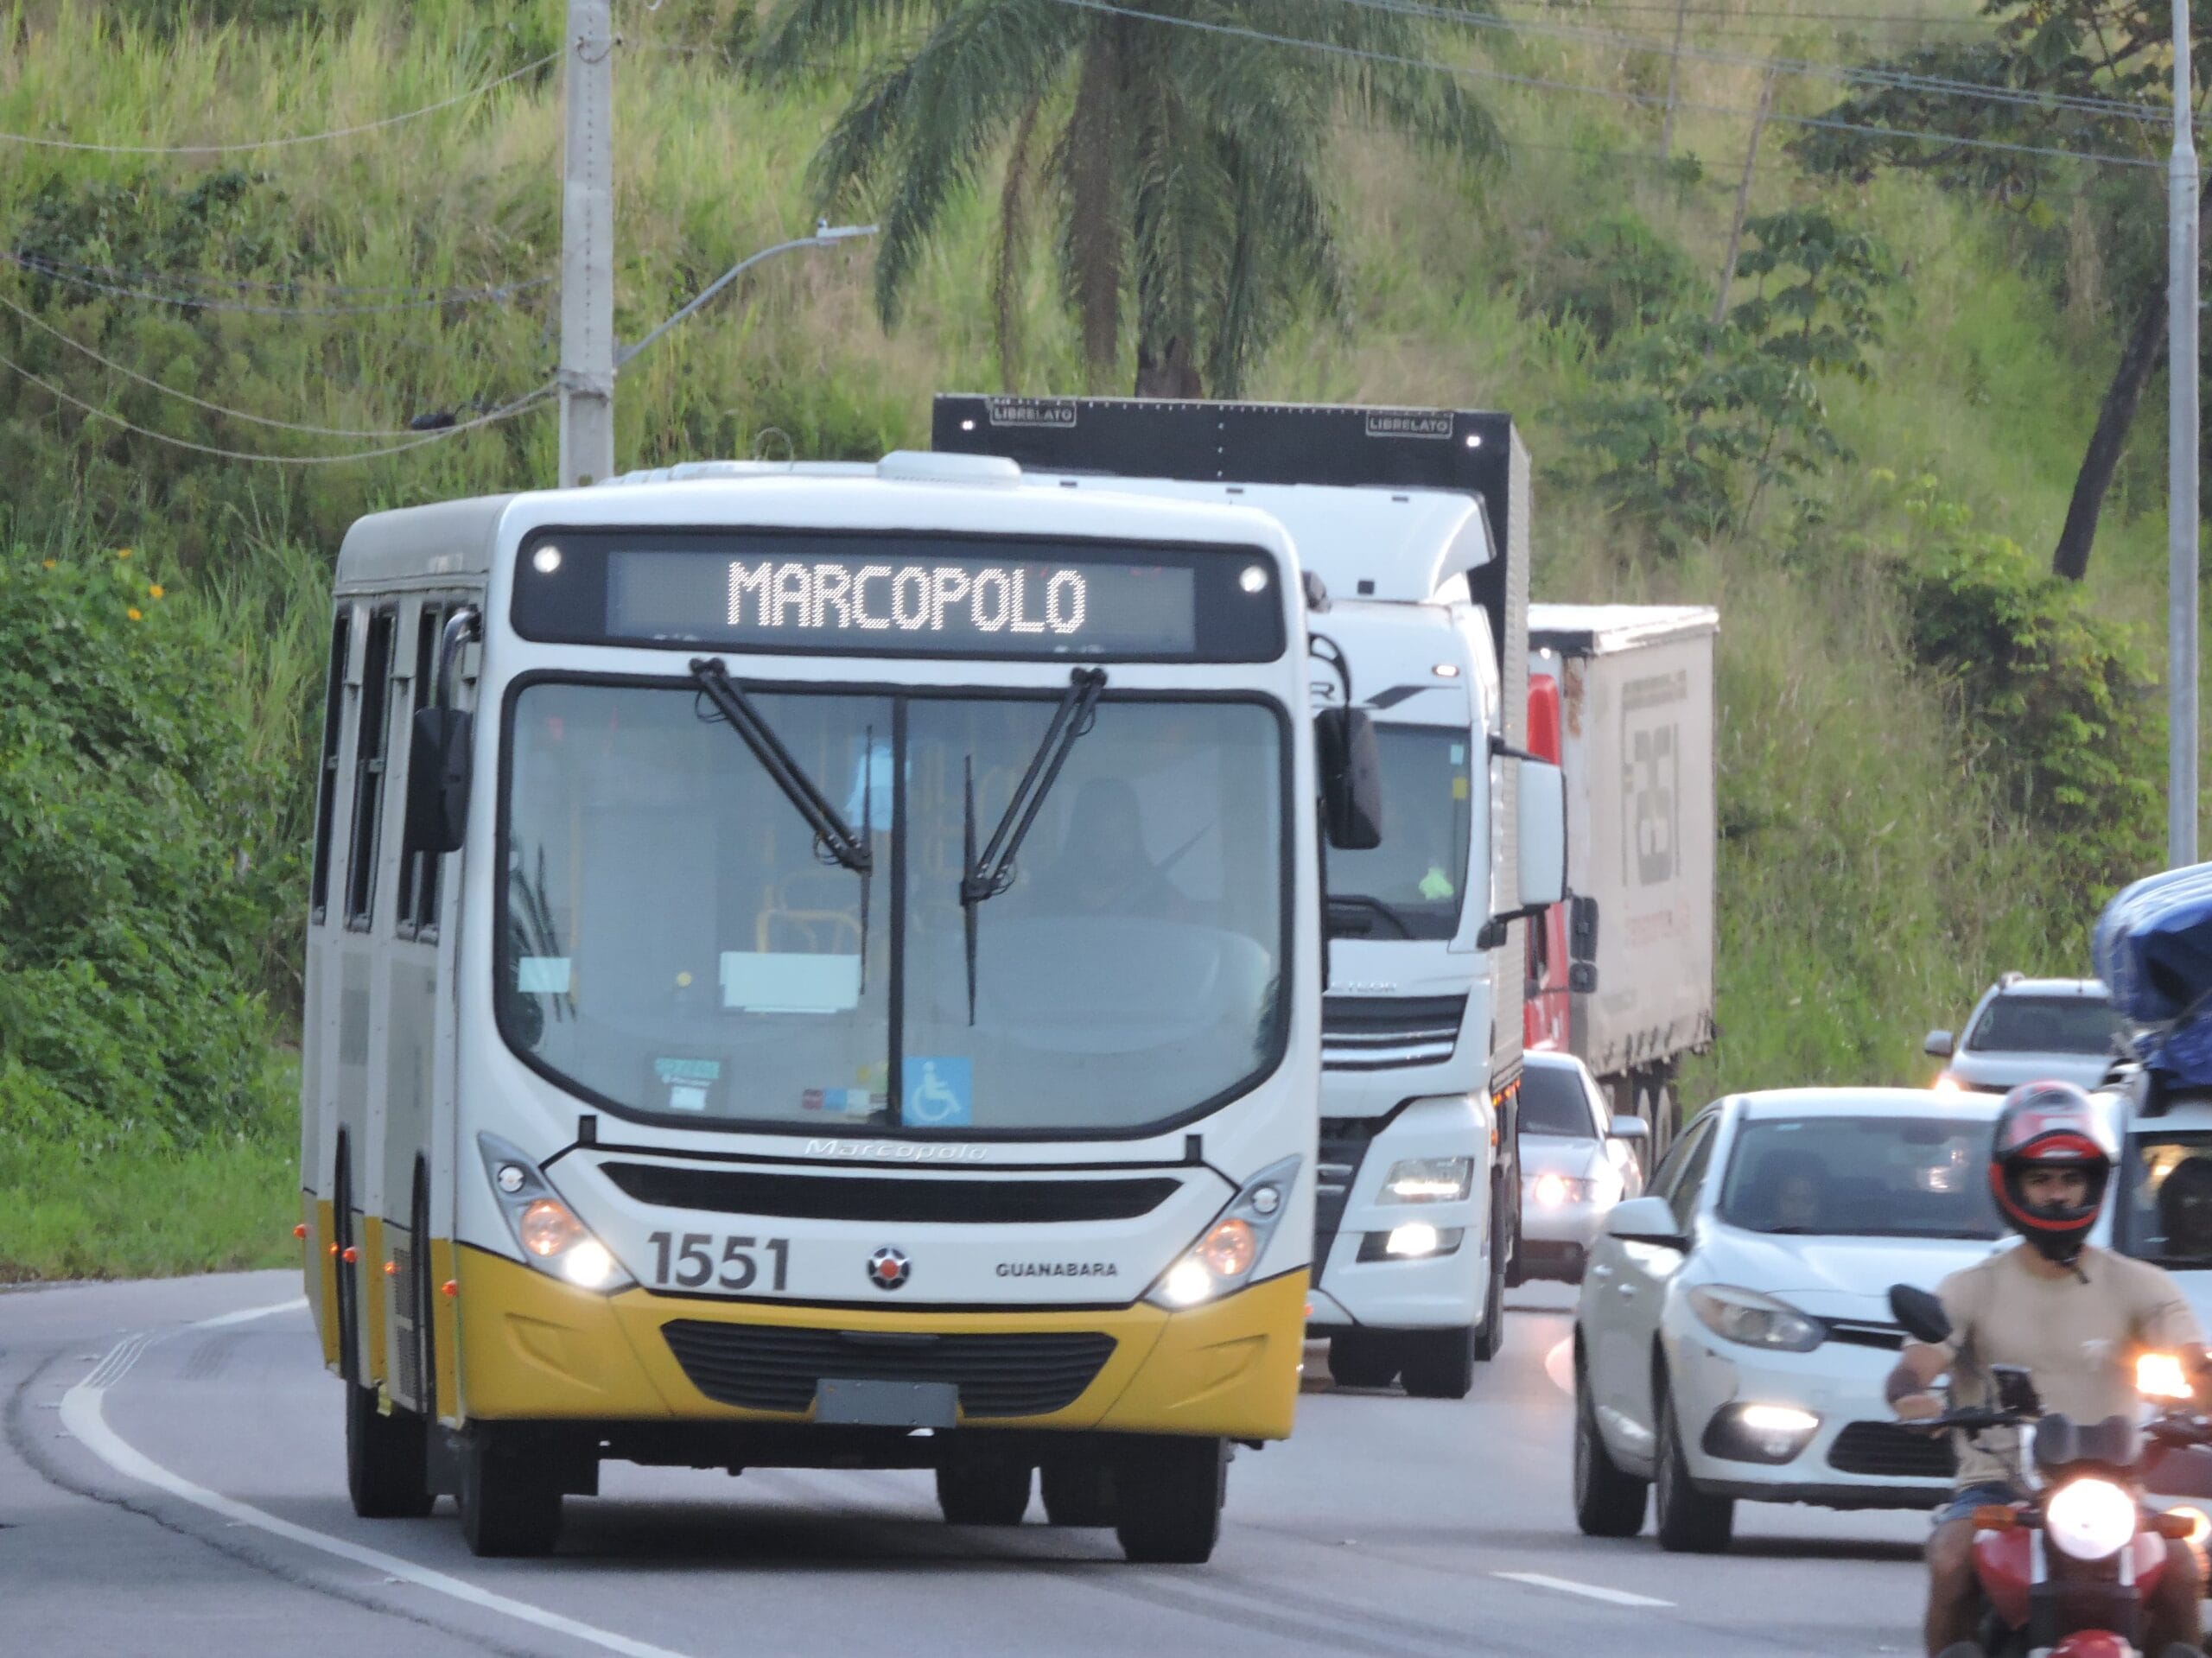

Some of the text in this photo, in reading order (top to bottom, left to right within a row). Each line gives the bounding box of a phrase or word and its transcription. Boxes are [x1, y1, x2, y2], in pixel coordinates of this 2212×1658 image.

[727, 561, 1086, 634] MARCOPOLO
[804, 1139, 988, 1162] Marcopolo
[647, 1231, 790, 1291] 1551
[995, 1262, 1118, 1277] GUANABARA
